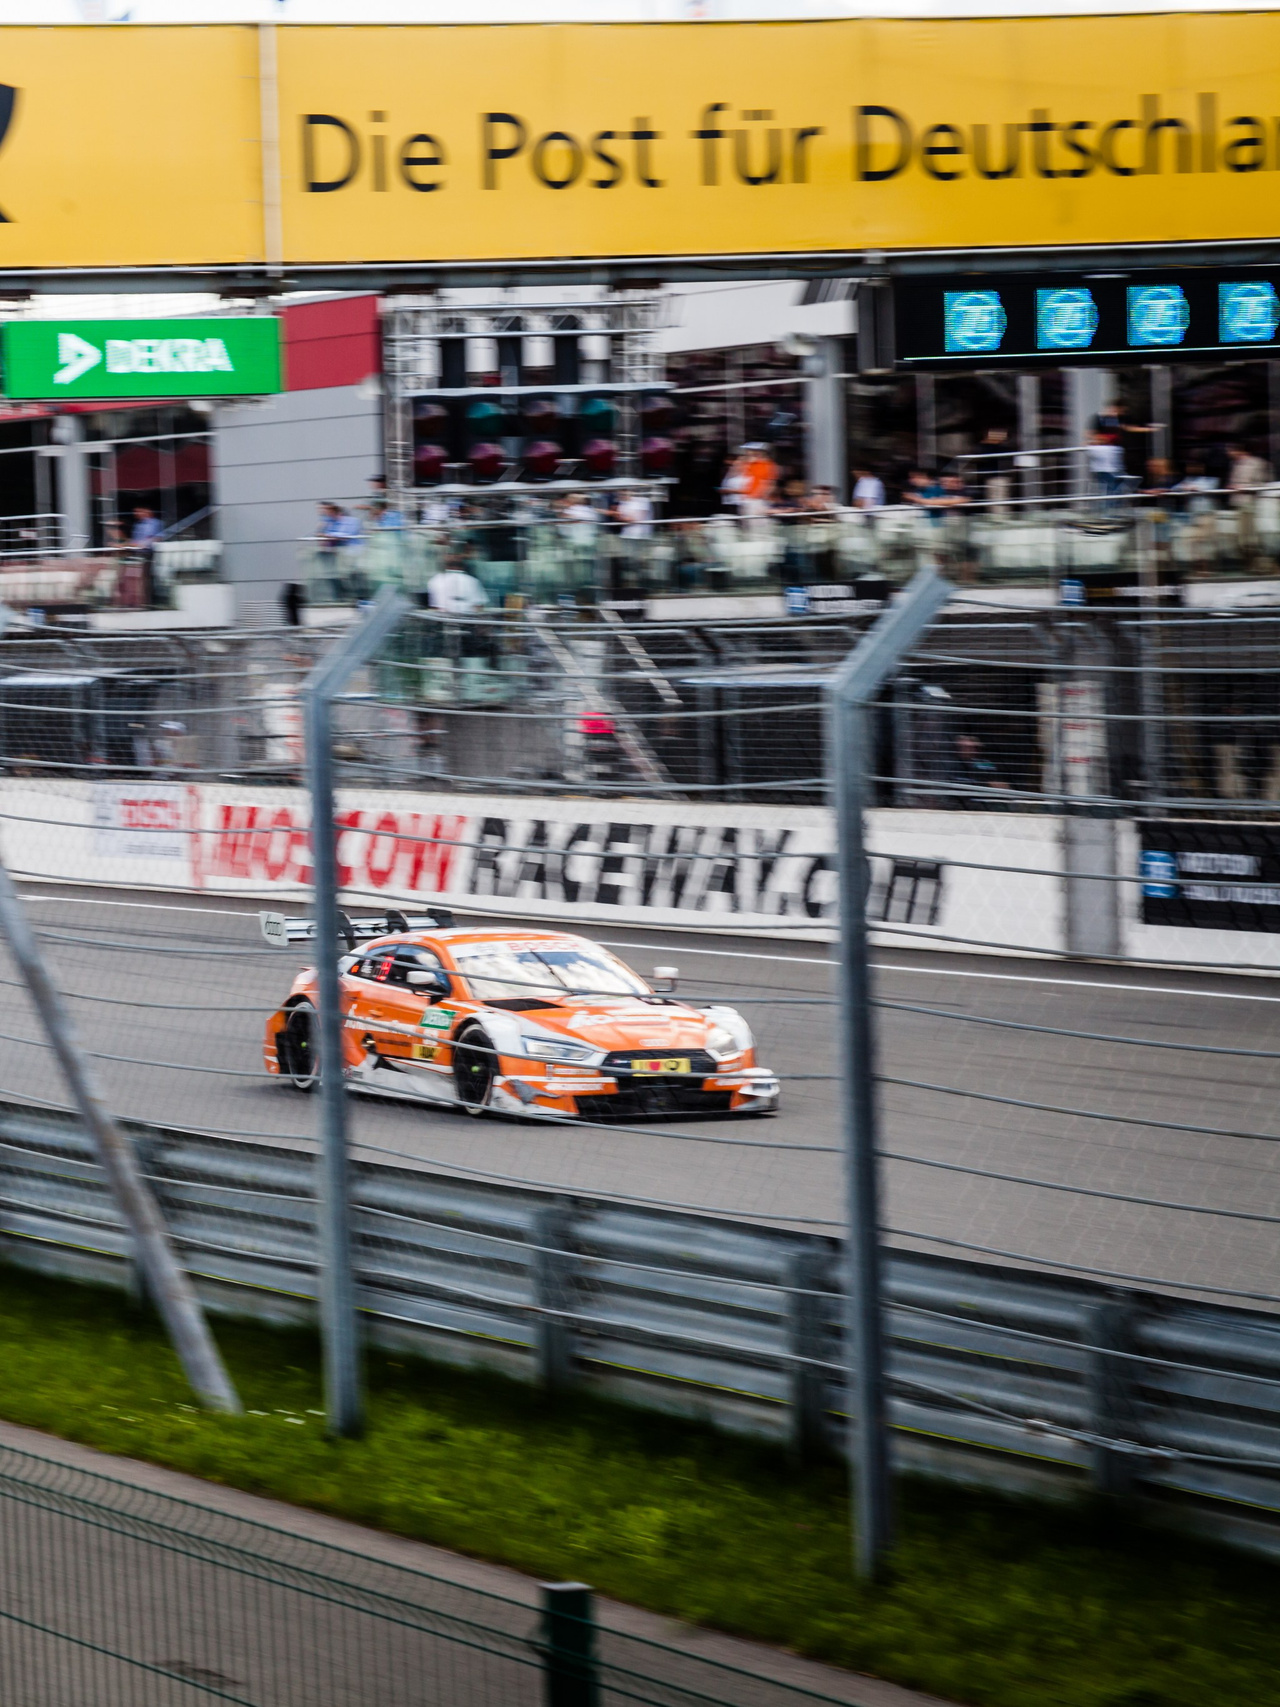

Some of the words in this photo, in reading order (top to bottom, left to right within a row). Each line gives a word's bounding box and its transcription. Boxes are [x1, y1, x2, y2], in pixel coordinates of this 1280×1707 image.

[300, 108, 445, 193] Die
[483, 110, 663, 191] Post
[695, 101, 824, 186] für
[854, 92, 1280, 182] Deutschla
[105, 337, 235, 374] DEKRA
[470, 815, 946, 927] RACEWAY.cm
